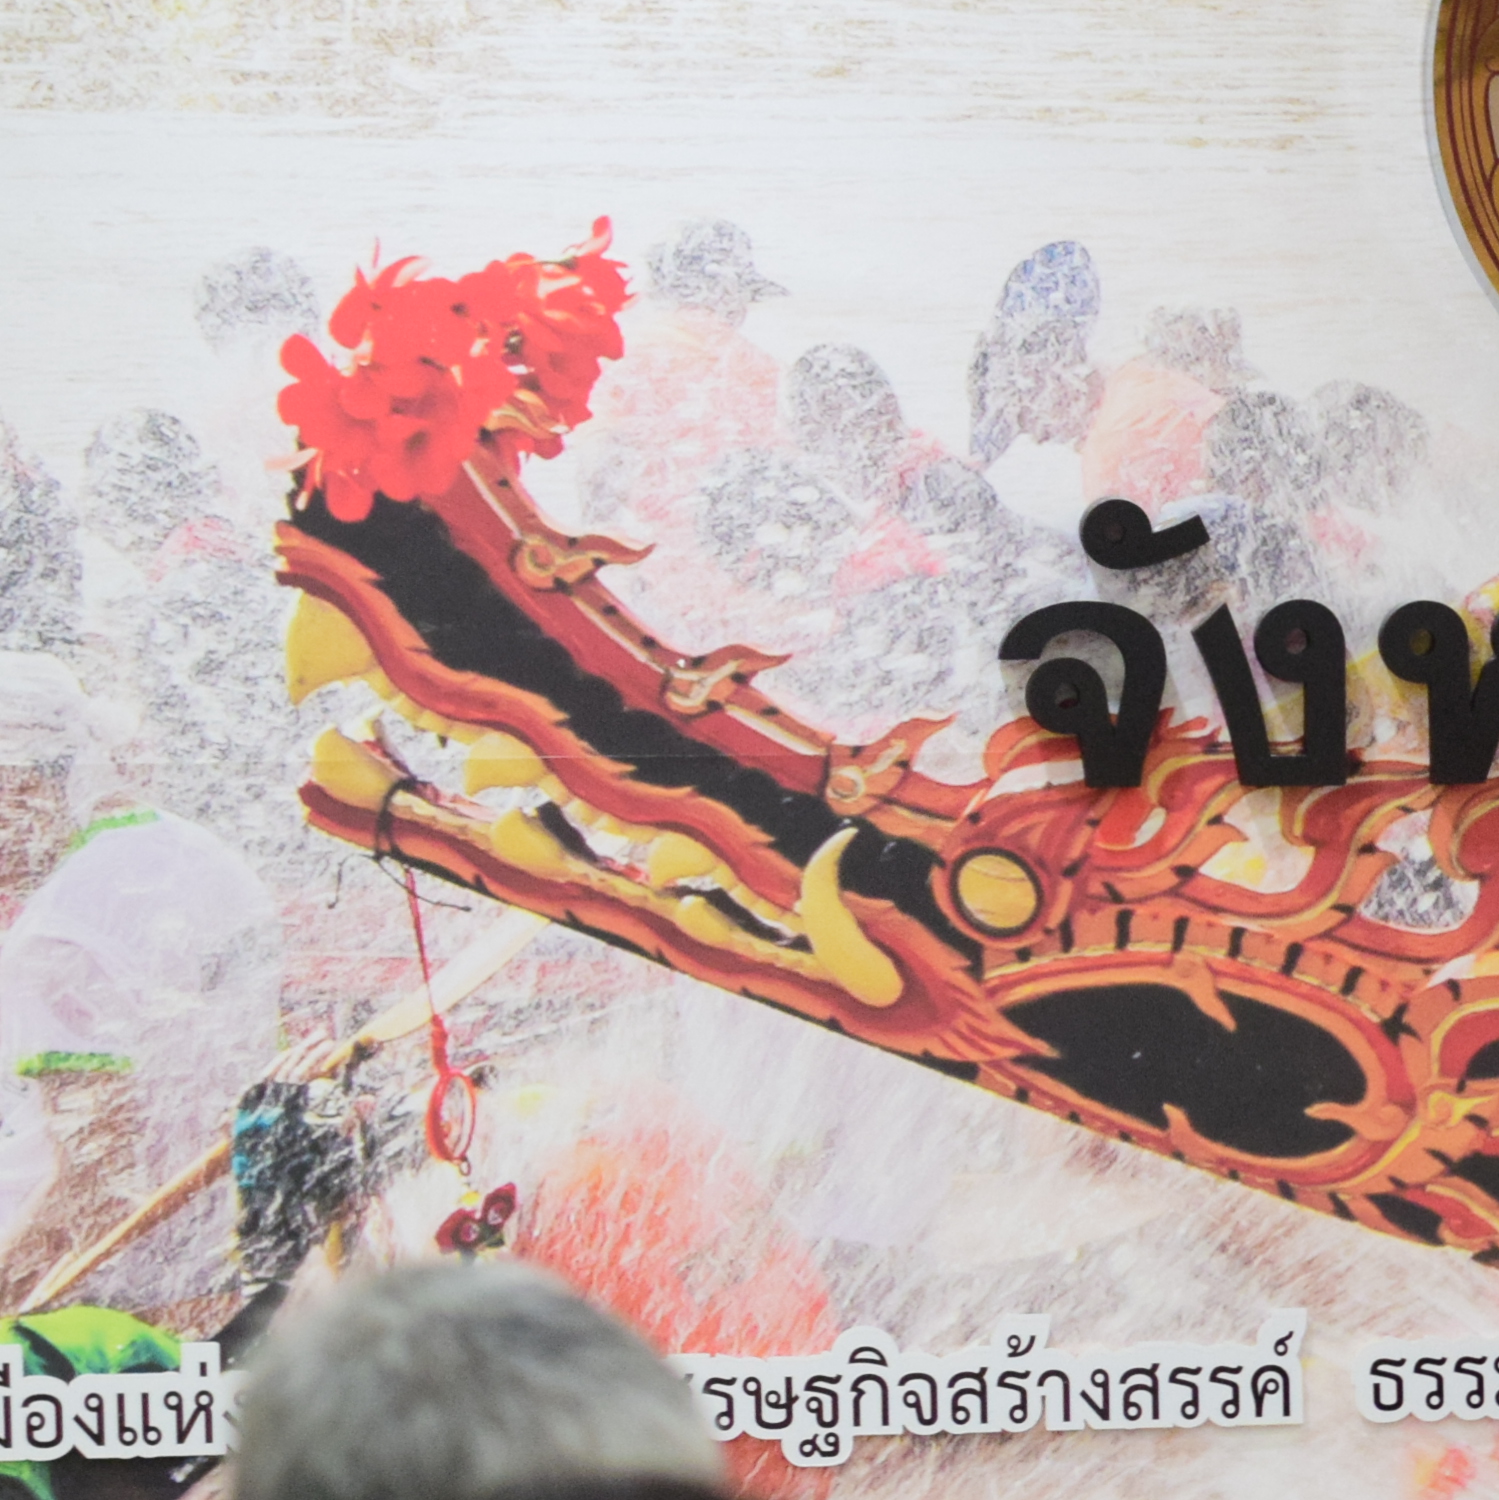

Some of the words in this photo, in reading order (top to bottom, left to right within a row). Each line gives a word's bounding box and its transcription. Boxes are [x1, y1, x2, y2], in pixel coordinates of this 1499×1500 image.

[684, 1330, 1292, 1458] รษฐกิจสร้างสรรค์
